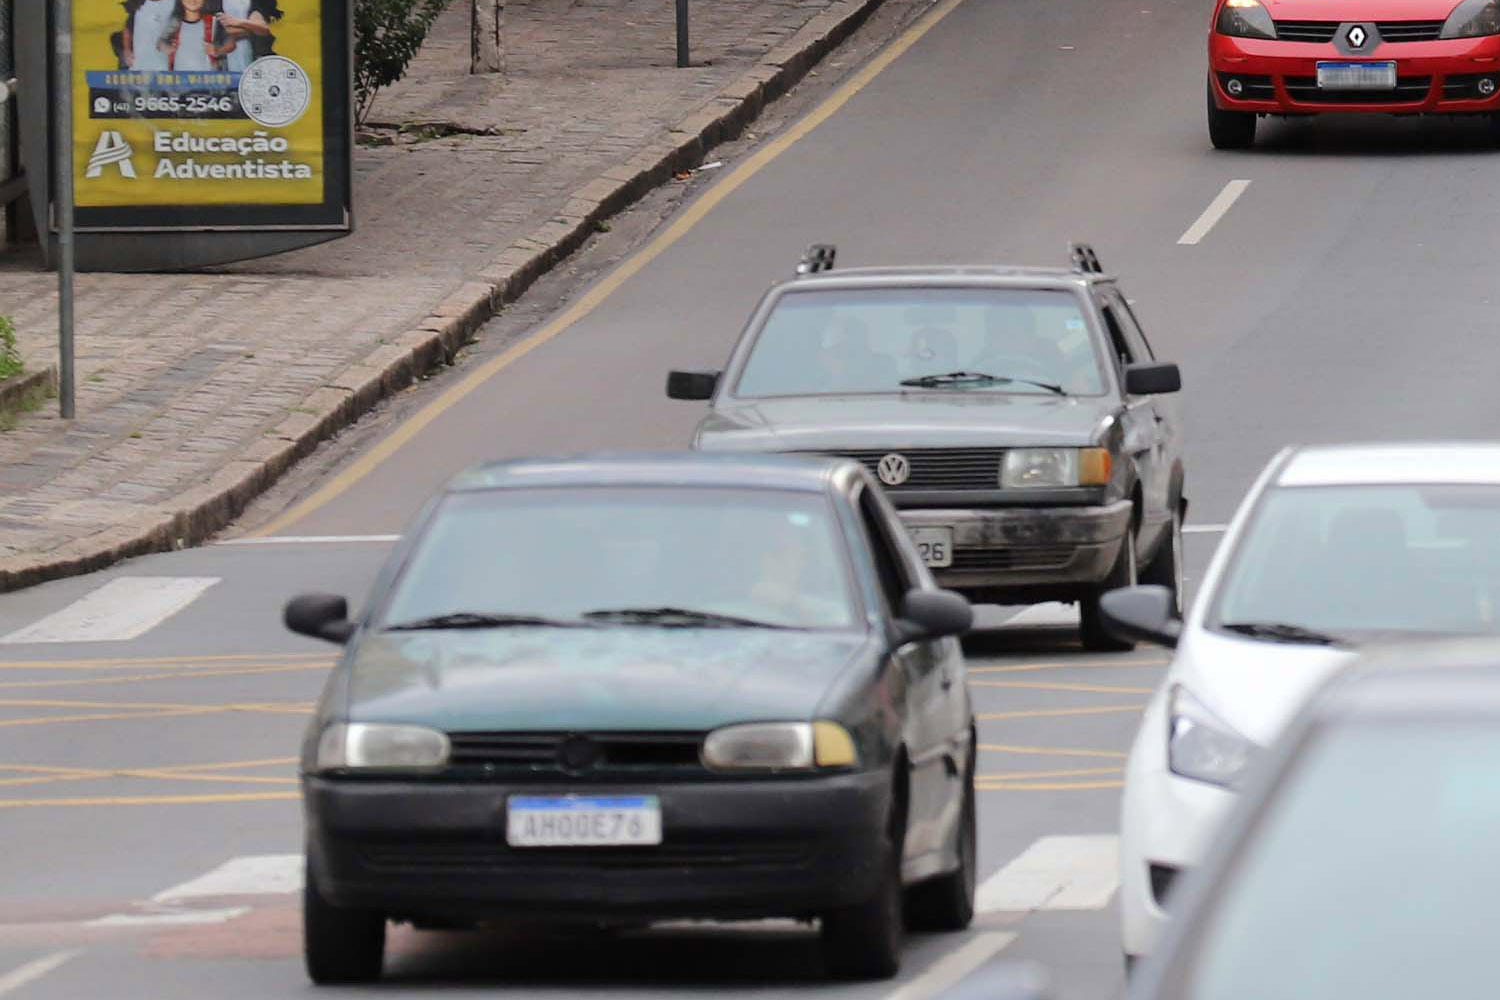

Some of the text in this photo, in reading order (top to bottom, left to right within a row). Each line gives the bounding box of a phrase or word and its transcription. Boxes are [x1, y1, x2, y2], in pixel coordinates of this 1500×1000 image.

[135, 96, 232, 112] 9665-2546
[154, 131, 288, 155] Educação
[154, 158, 312, 179] Adventista
